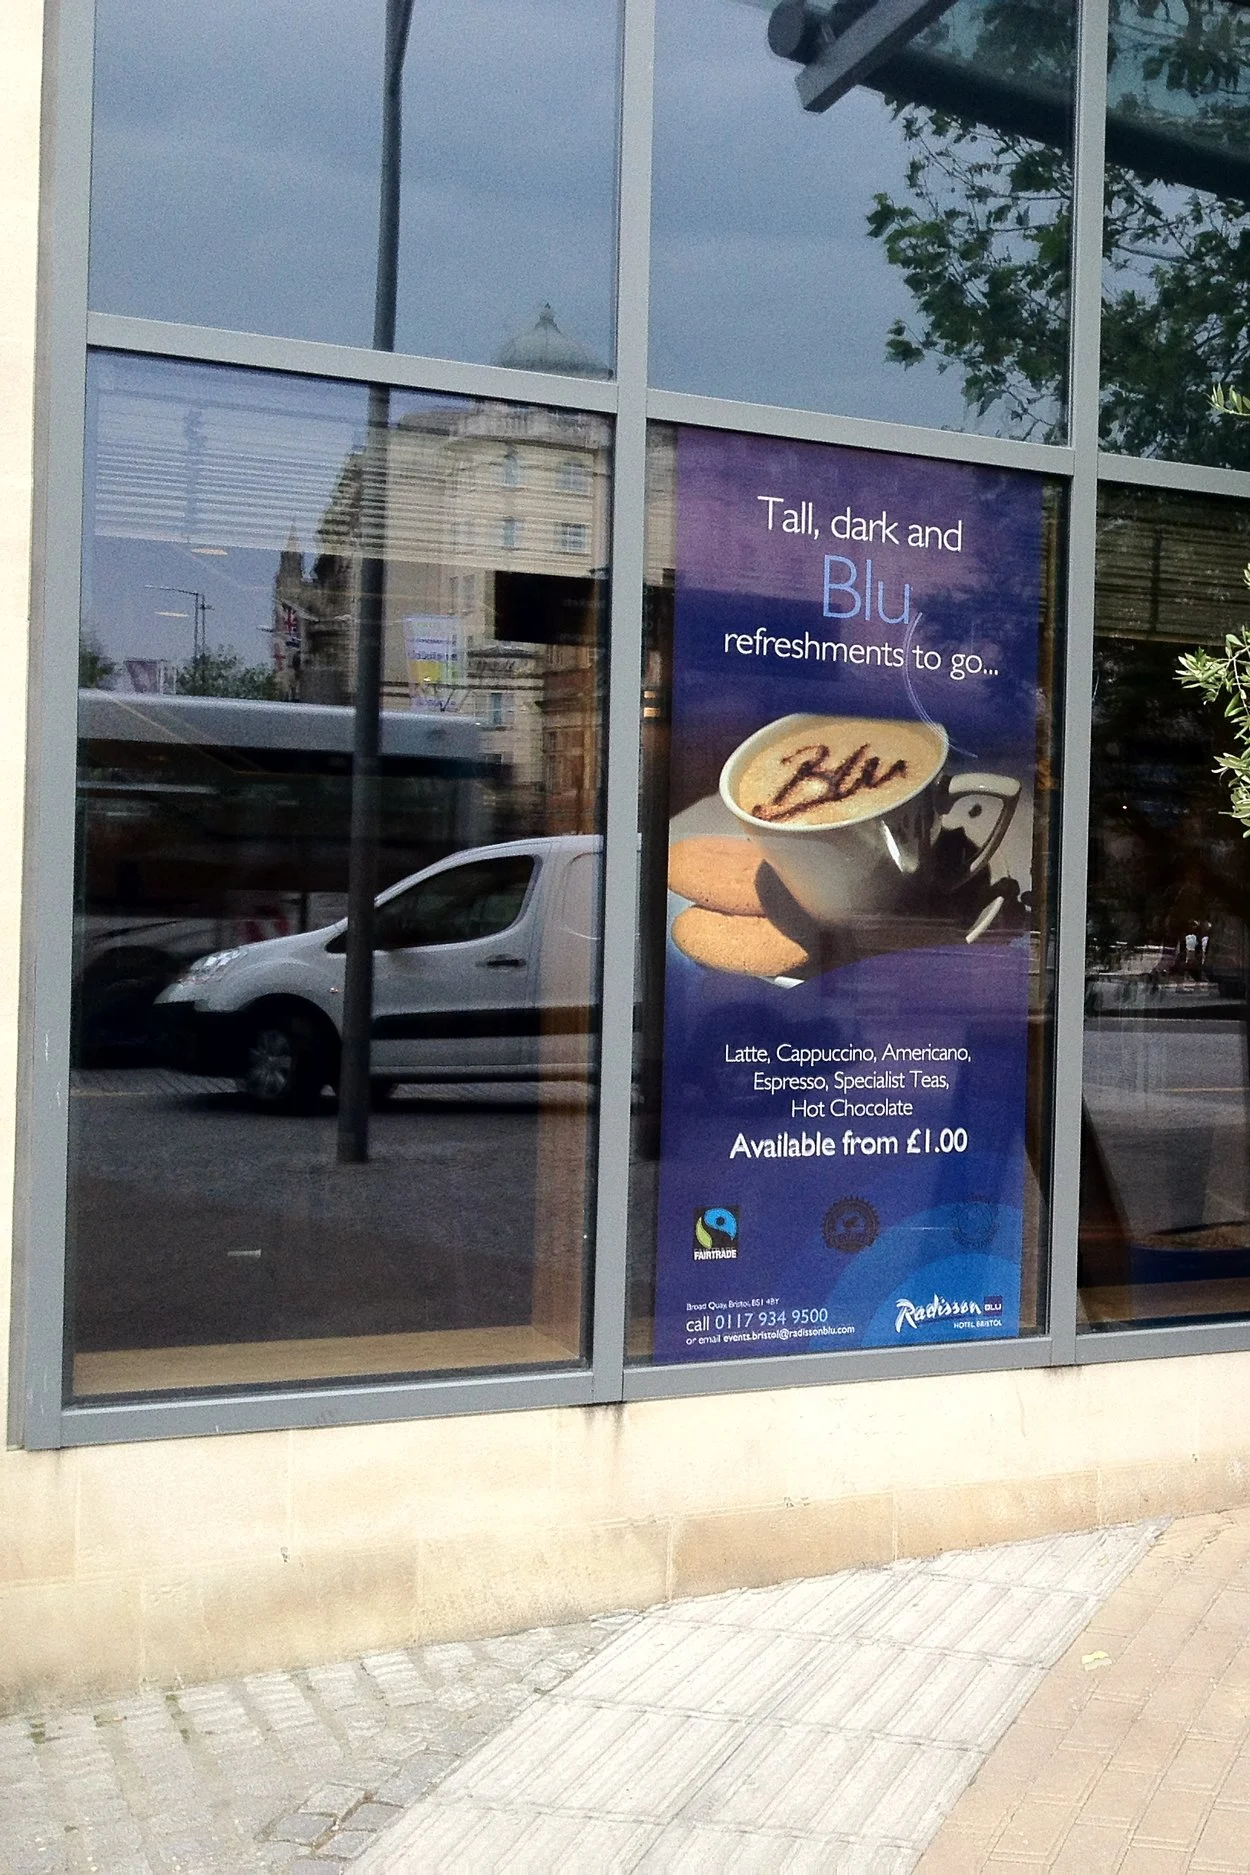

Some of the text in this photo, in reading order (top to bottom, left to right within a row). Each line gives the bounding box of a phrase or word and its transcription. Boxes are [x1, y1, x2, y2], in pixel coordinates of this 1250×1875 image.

[757, 496, 962, 552] Tall, dark and
[822, 555, 911, 624] Blu
[723, 627, 999, 680] refreshments to go...
[725, 1043, 972, 1067] Latte, Cappuccino, Americano,
[753, 1070, 950, 1094] Espresso, Specialist Teas,
[791, 1099, 913, 1118] Hot Chocolate
[729, 1127, 968, 1159] Available from £1.00
[693, 1248, 737, 1261] FAIRTRADE
[686, 1302, 707, 1311] Broad
[895, 1291, 1002, 1333] Radisson BLU
[686, 1308, 828, 1332] call 0117 934 9500
[953, 1319, 1003, 1329] HOTEL BRISTOL
[686, 1325, 855, 1346] or email events.bristol@radissonblu.com
